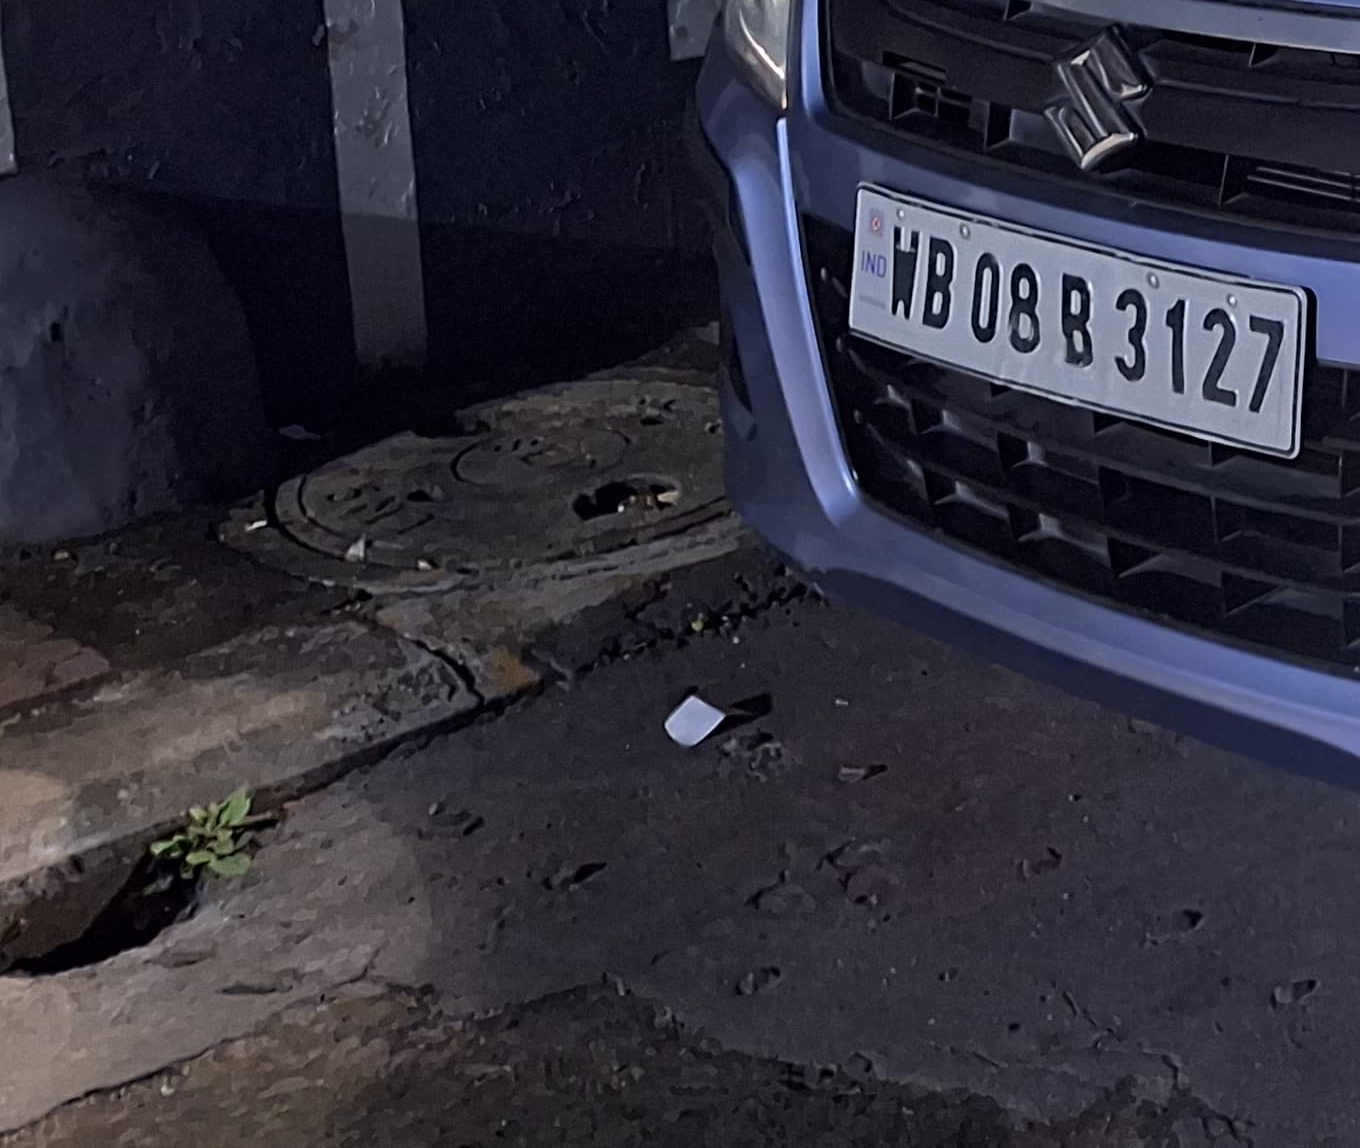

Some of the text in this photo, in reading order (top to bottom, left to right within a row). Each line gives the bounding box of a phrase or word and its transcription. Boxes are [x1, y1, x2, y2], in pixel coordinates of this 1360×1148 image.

[861, 250, 887, 278] IND
[891, 225, 1285, 414] WB 08 B 3127
